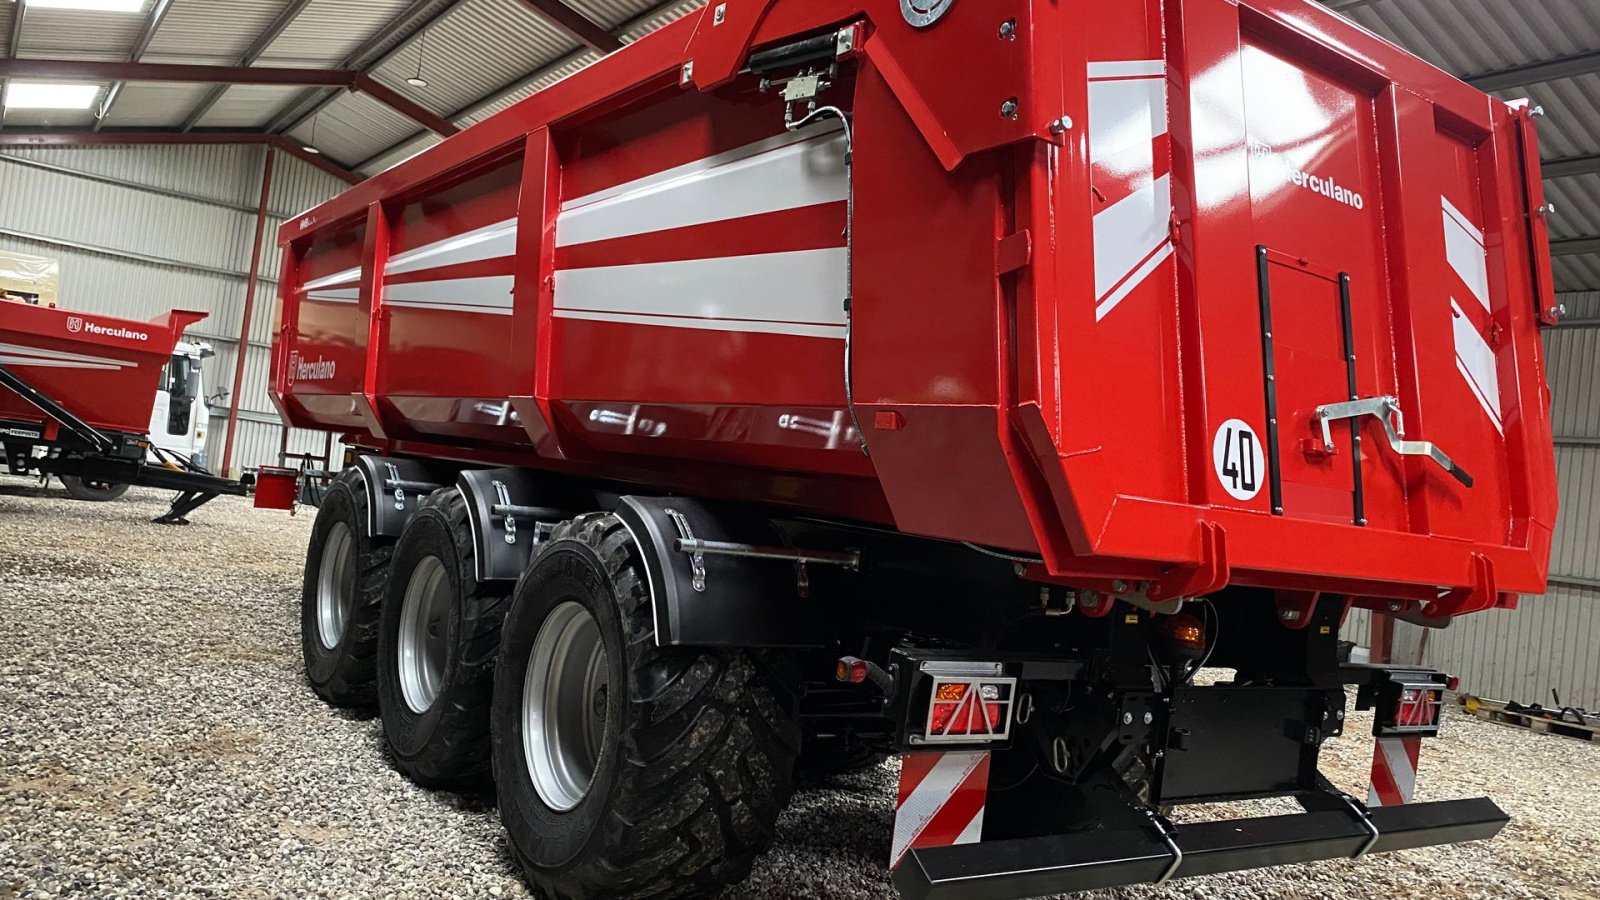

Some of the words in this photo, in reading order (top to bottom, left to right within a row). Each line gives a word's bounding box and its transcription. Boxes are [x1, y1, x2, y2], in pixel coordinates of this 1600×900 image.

[1284, 160, 1364, 210] erculano
[84, 321, 148, 341] Herculano
[296, 354, 336, 380] Herculano
[1222, 427, 1256, 492] 40
